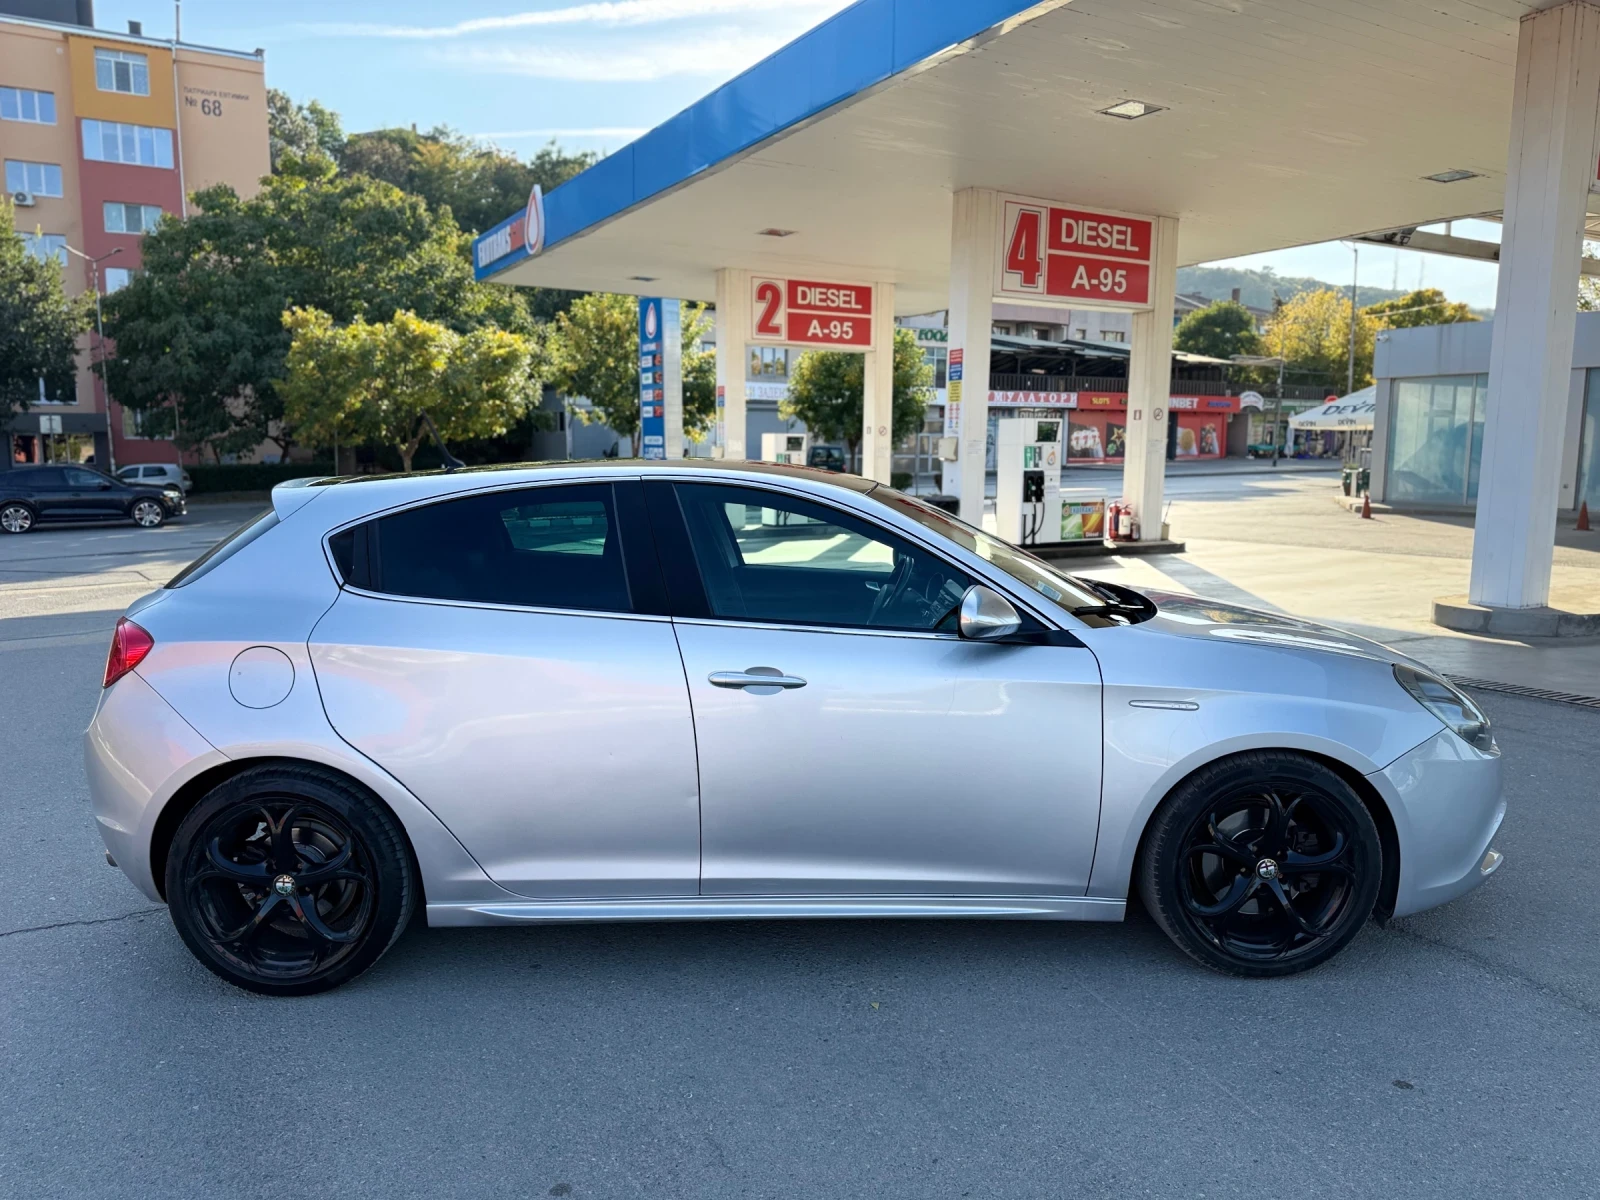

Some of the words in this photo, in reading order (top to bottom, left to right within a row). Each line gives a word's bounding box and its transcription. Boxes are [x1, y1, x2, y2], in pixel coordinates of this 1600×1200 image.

[201, 98, 222, 117] 68
[1060, 217, 1140, 252] DIESEL
[1005, 208, 1043, 289] 4
[1071, 265, 1128, 294] A-95
[756, 281, 783, 336] 2
[797, 286, 862, 309] DIESEL
[806, 319, 853, 340] A-95
[988, 391, 1077, 404] МУЛАТОРИ
[1091, 397, 1110, 405] SLOTS
